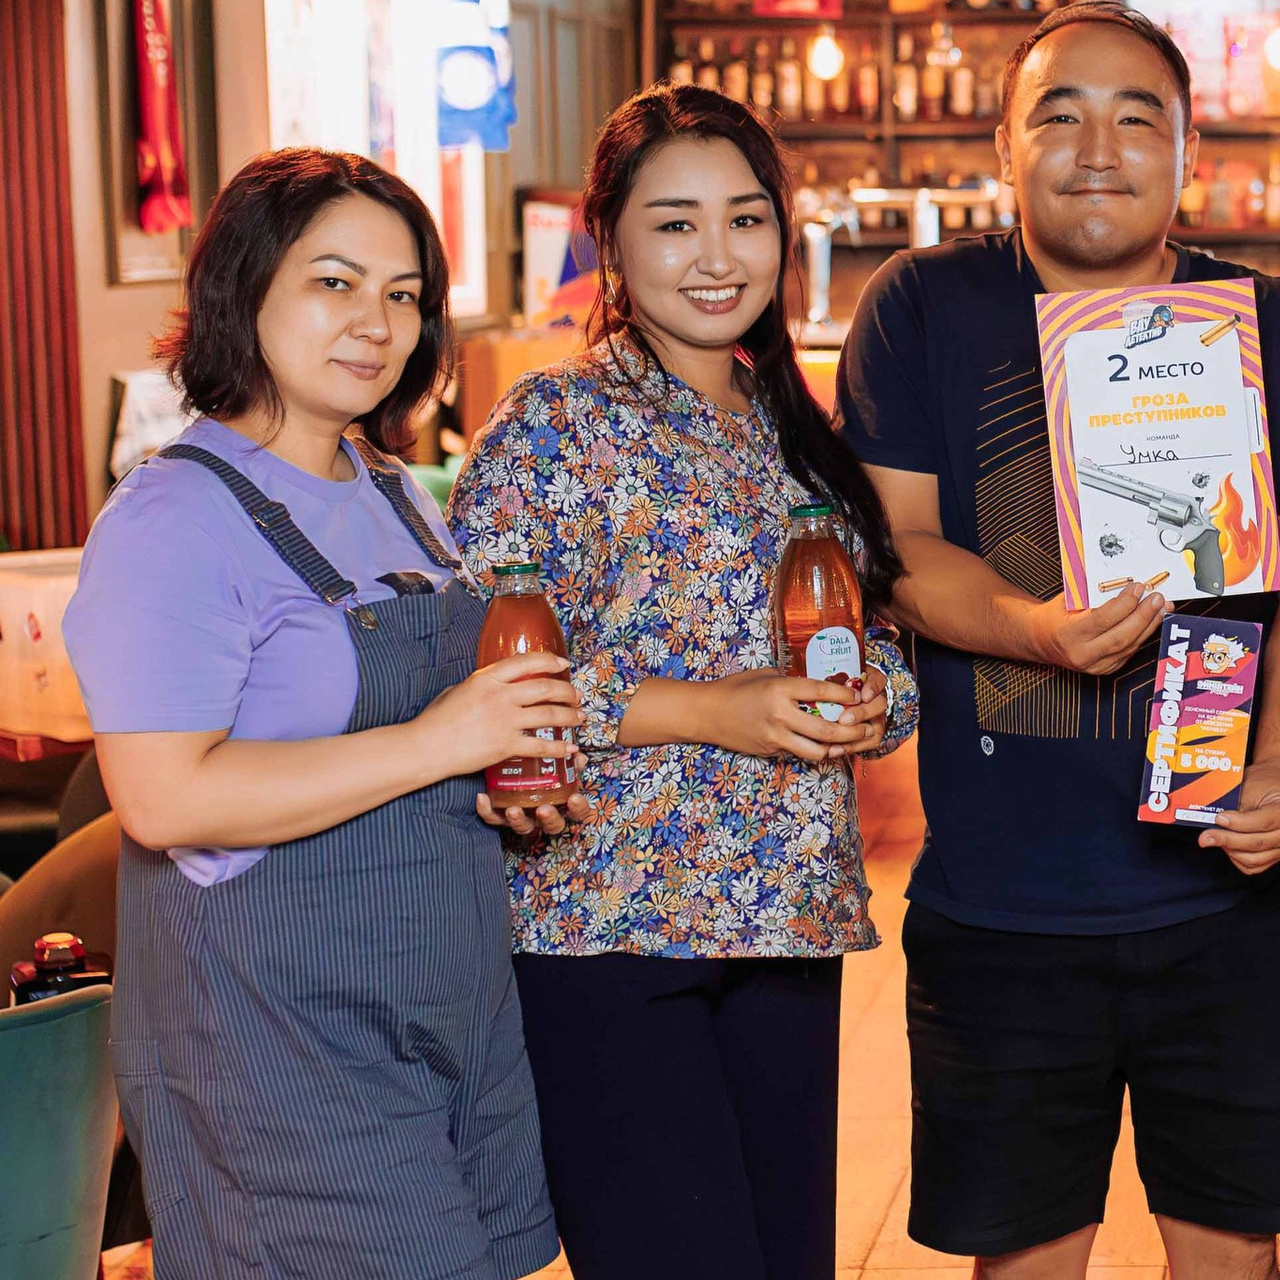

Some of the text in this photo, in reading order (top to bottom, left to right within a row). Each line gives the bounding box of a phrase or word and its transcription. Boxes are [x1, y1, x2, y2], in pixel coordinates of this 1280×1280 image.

[1108, 354, 1205, 382] 2 МЕСТО
[1132, 391, 1189, 408] ГРОЗА
[1088, 404, 1227, 428] ПРЕСТУПНИКОВ
[1146, 432, 1180, 441] КОМАНДА
[829, 636, 850, 645] DALA
[829, 646, 852, 656] FRUIT
[1147, 623, 1191, 813] СЕРТИФИКАТ
[1195, 755, 1231, 772] 000
